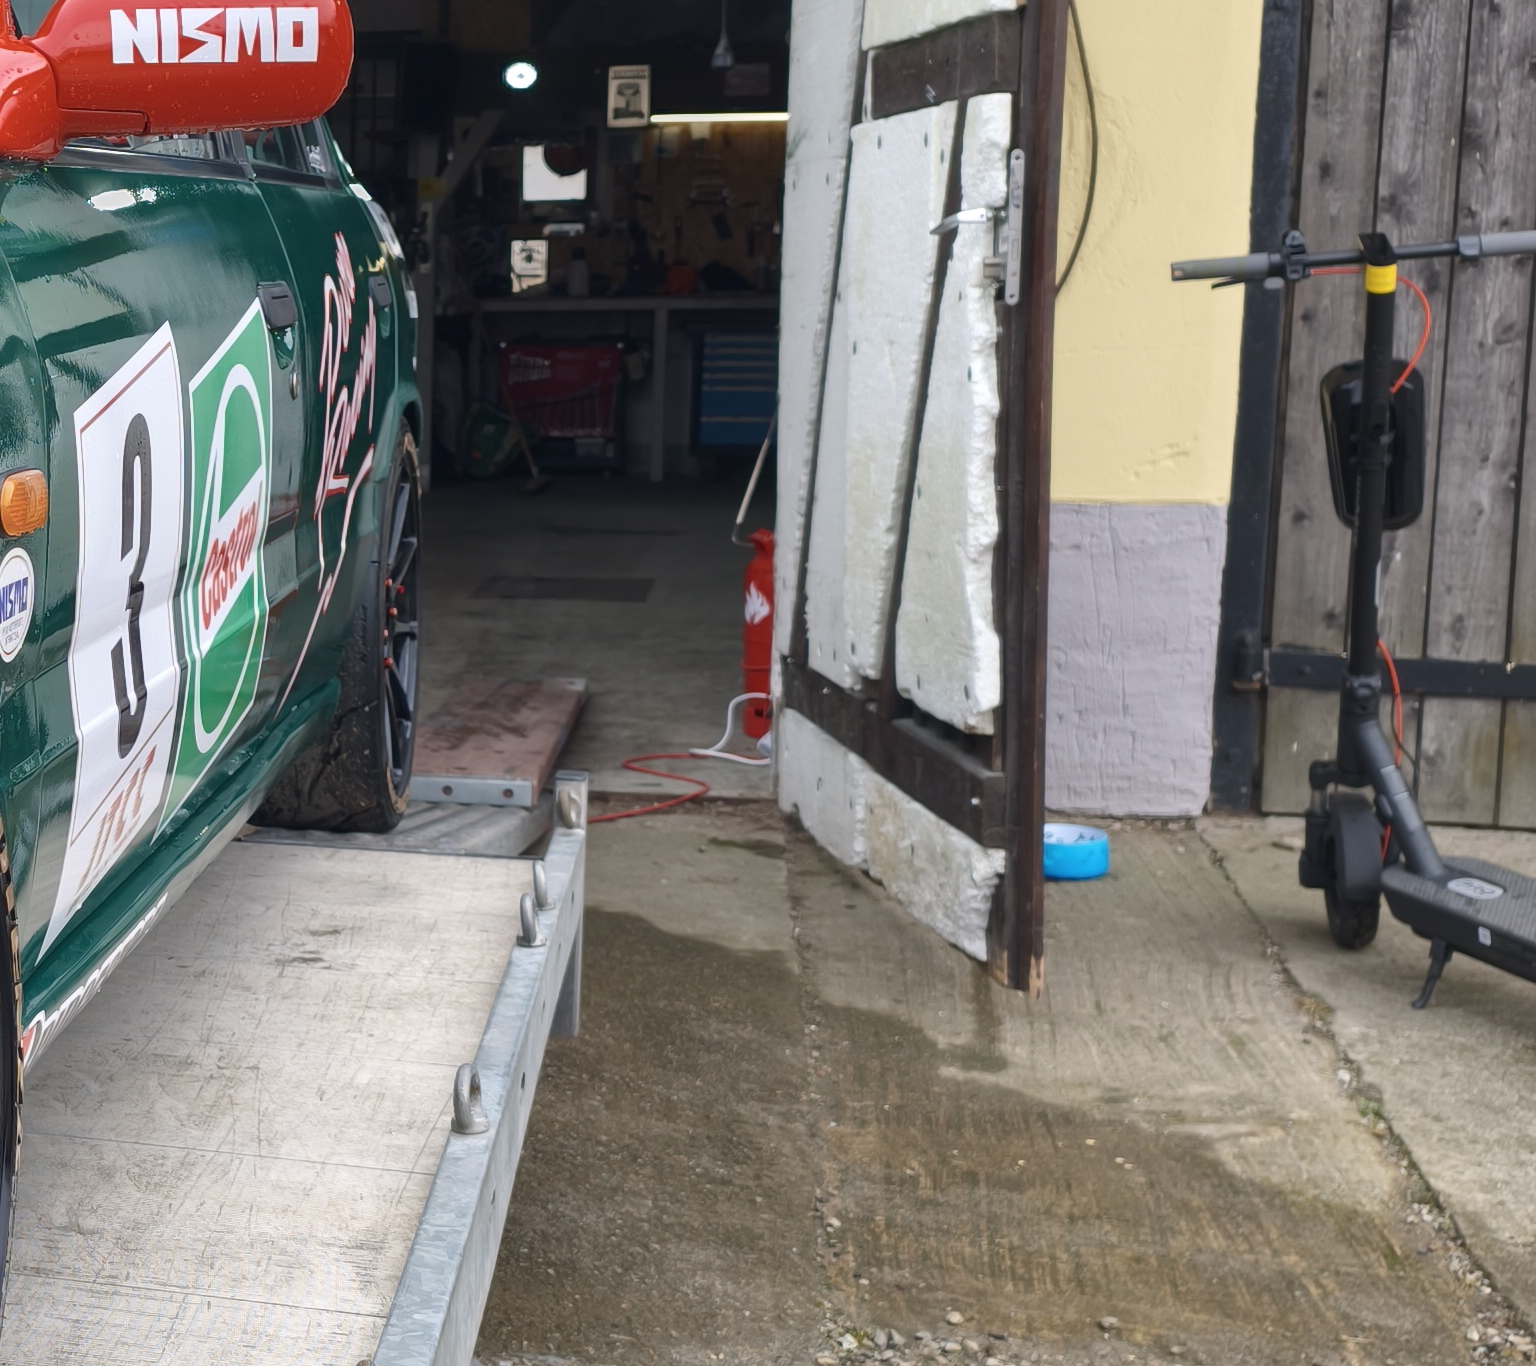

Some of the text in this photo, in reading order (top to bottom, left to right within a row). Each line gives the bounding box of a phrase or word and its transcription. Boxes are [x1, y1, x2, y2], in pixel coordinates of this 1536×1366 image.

[109, 6, 319, 65] NISMO
[110, 413, 152, 759] 3
[201, 480, 263, 631] Castrol
